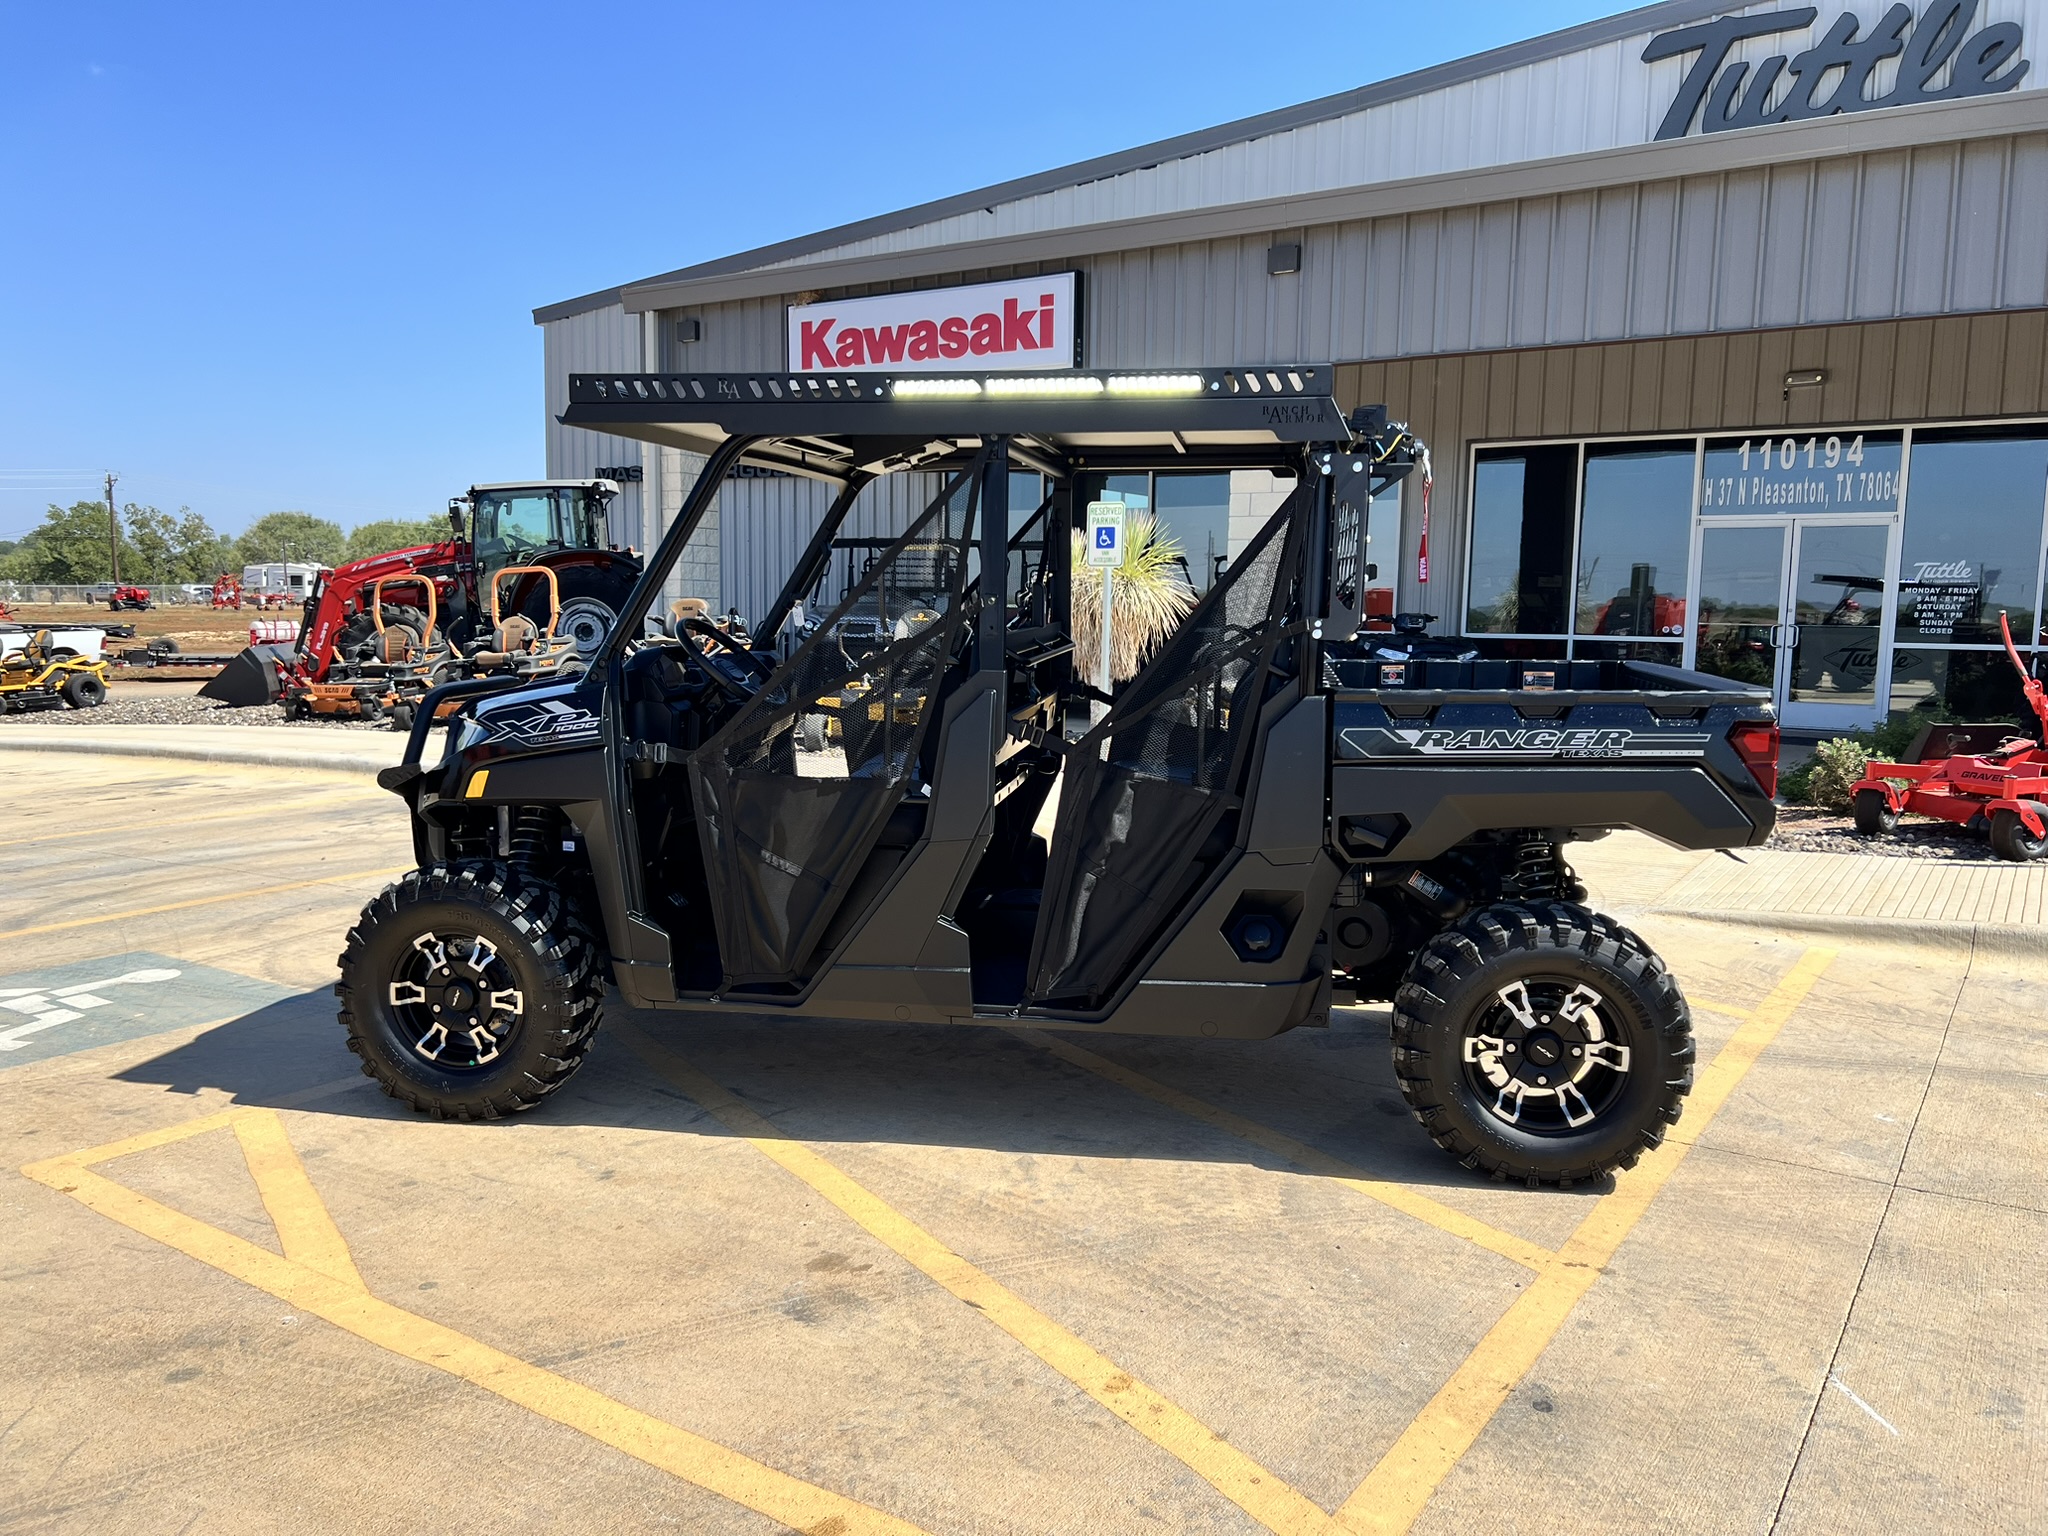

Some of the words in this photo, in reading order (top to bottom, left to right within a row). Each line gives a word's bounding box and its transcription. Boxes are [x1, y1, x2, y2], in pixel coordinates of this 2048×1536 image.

[1641, 0, 2030, 141] Tuttle
[801, 294, 1055, 370] Kawasaki
[1262, 406, 1309, 418] RANCH
[1738, 435, 1863, 471] 110194
[1718, 477, 1733, 506] 37
[1738, 476, 1747, 506] N
[1752, 475, 1829, 509] Pleasanton,
[1837, 472, 1853, 502] TX
[1859, 470, 1899, 501] 78064
[1090, 506, 1122, 516] RESERVED
[1092, 516, 1121, 526] PARKING
[1914, 560, 1972, 583] Tuttle
[556, 721, 600, 733] 1000
[1412, 729, 1633, 749] RANGER
[1561, 749, 1623, 758] TEXAS
[1577, 957, 1654, 1031] X-TERRAIN
